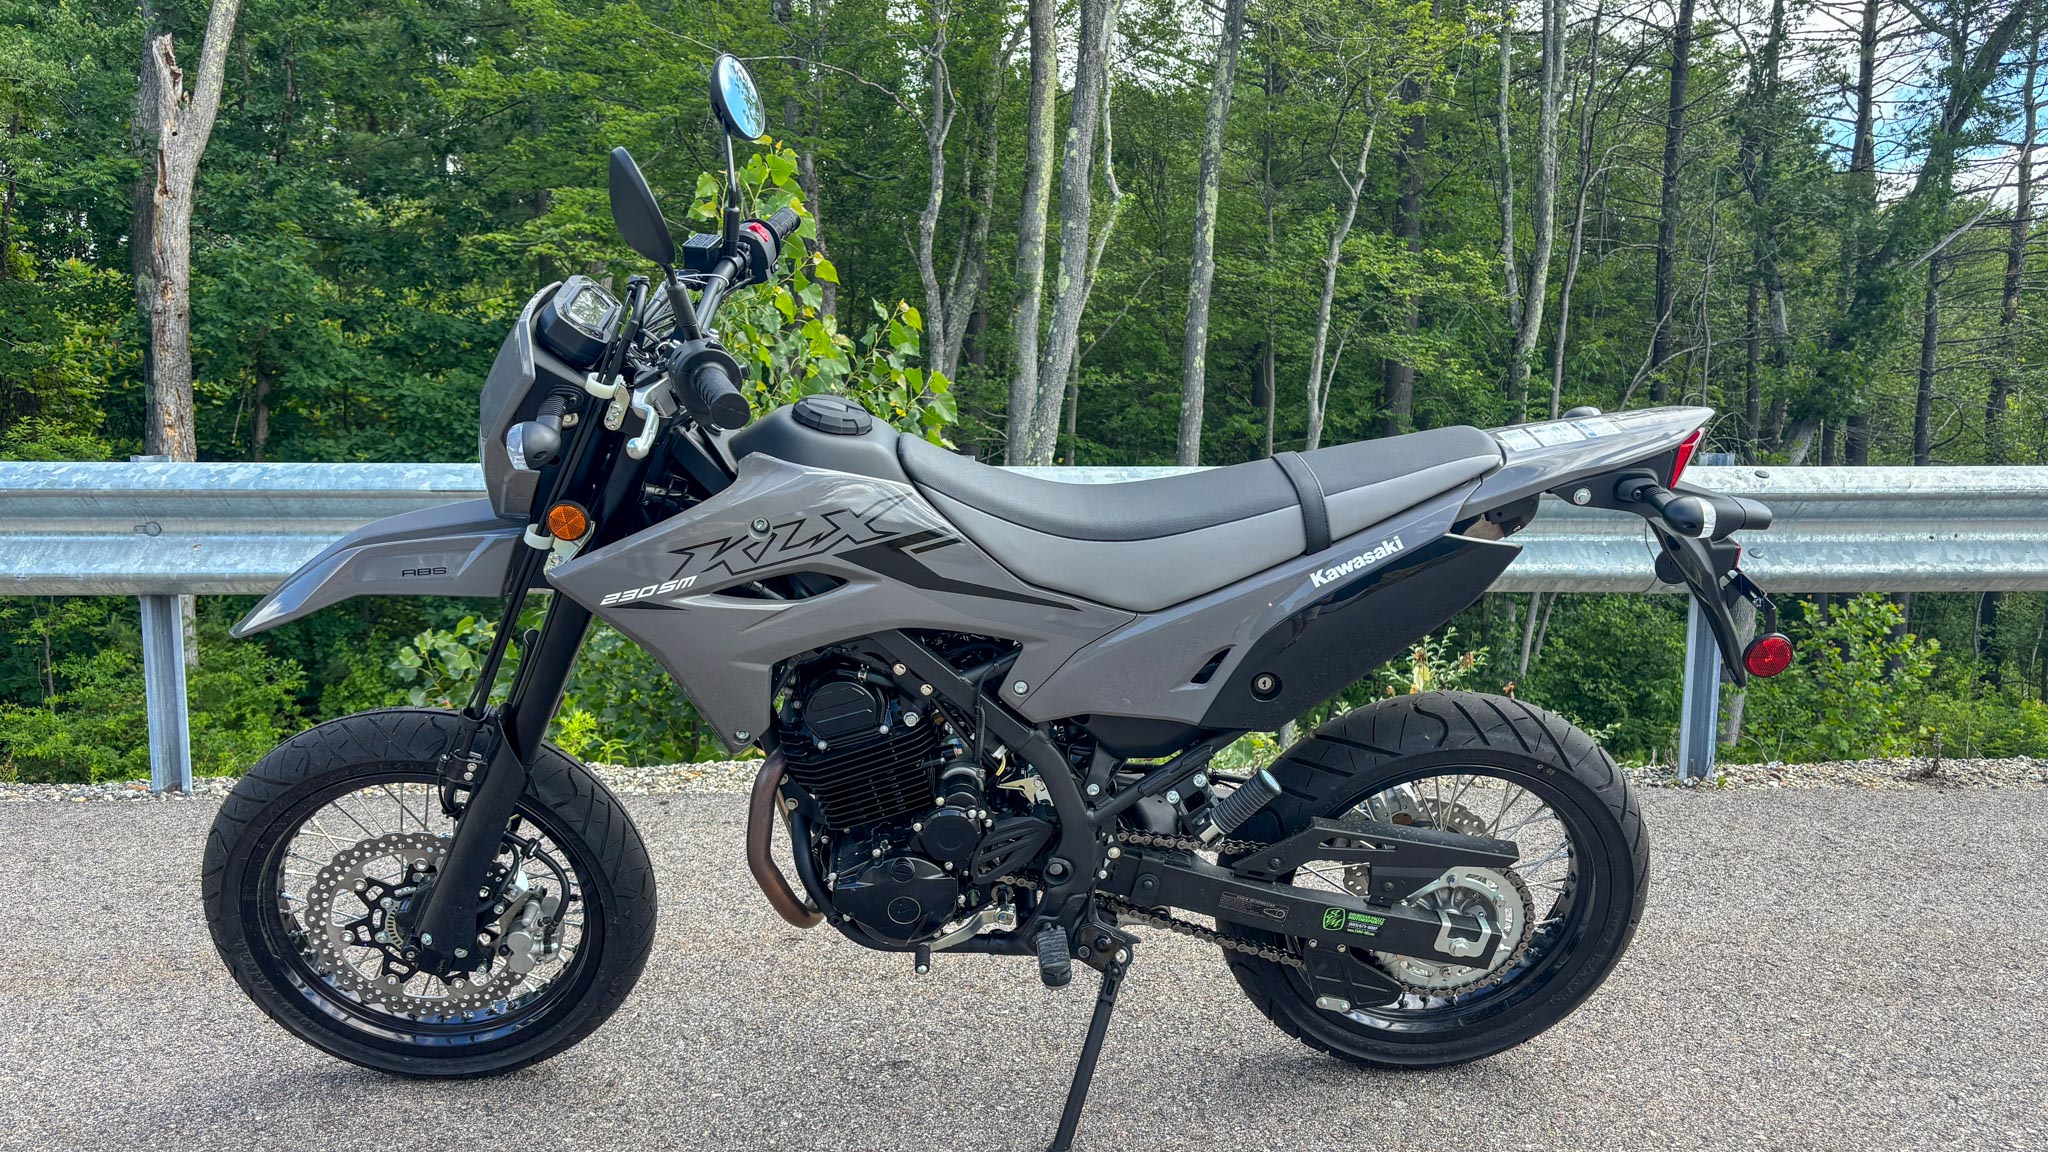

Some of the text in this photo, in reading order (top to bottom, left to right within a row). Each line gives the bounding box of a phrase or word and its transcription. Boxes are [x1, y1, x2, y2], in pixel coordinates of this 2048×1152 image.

[666, 491, 914, 580] KLX
[401, 566, 447, 577] ABS
[1309, 535, 1405, 588] Kawasaki
[600, 574, 698, 606] 230SM
